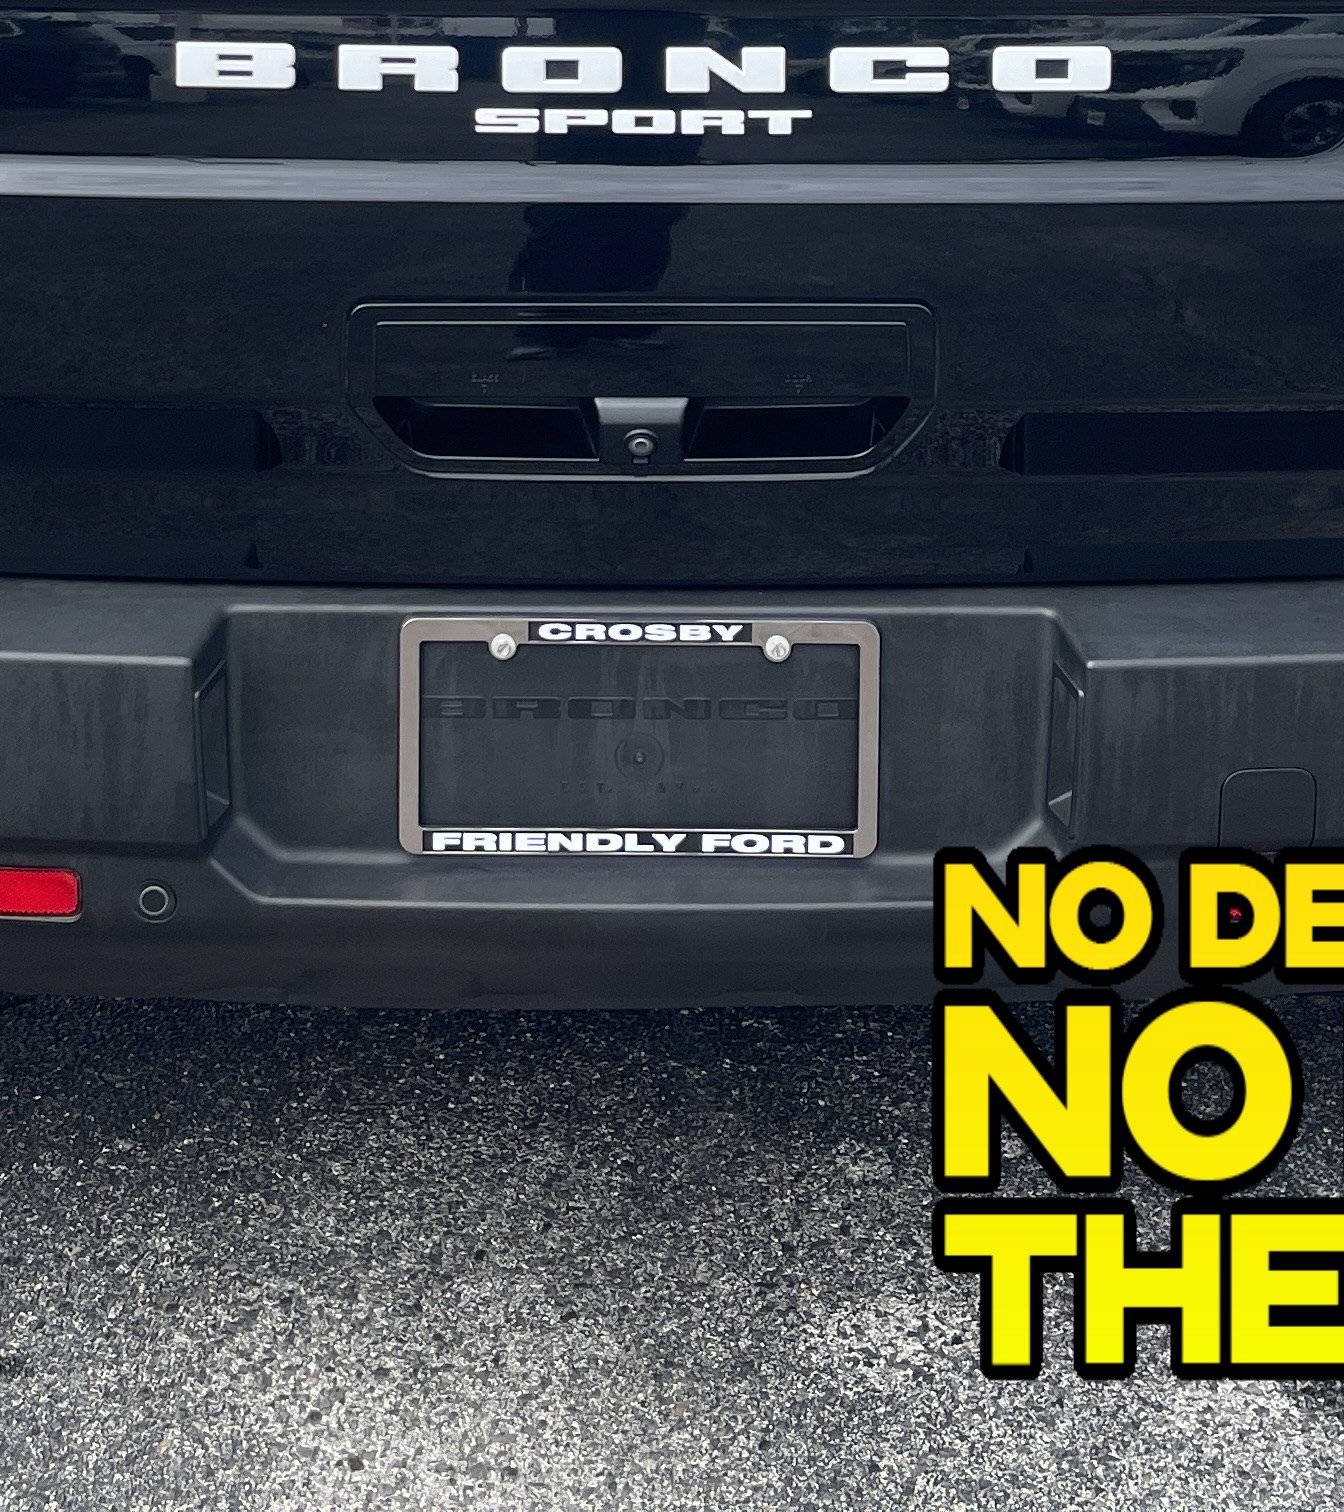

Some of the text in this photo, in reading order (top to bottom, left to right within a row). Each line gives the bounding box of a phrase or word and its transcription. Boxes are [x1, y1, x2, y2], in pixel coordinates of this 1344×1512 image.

[175, 40, 1113, 93] BRONCO
[474, 107, 813, 135] SPORT
[538, 622, 744, 641] CROSBY
[422, 694, 858, 720] BRONCO
[431, 832, 847, 854] FRIENDLY FORD
